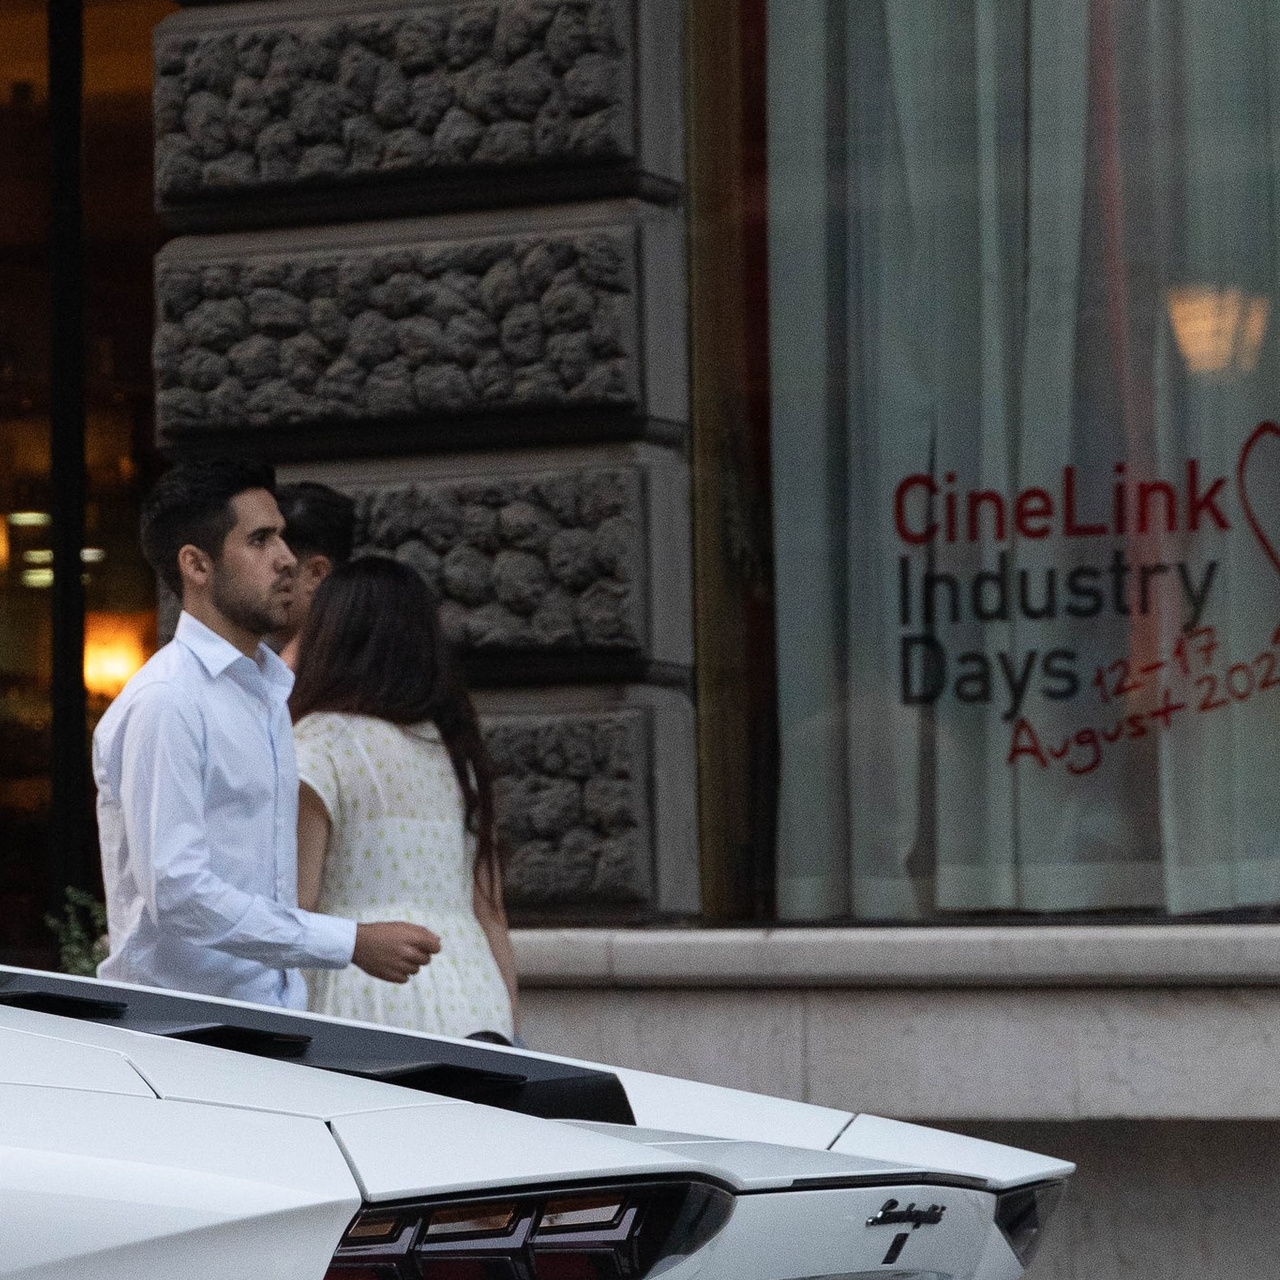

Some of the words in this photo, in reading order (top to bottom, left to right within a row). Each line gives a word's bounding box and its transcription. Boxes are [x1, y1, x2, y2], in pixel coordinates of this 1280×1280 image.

[894, 460, 1232, 545] CineLink
[898, 548, 1218, 632] Industry
[898, 632, 1080, 722] Days
[1007, 689, 1186, 776] August
